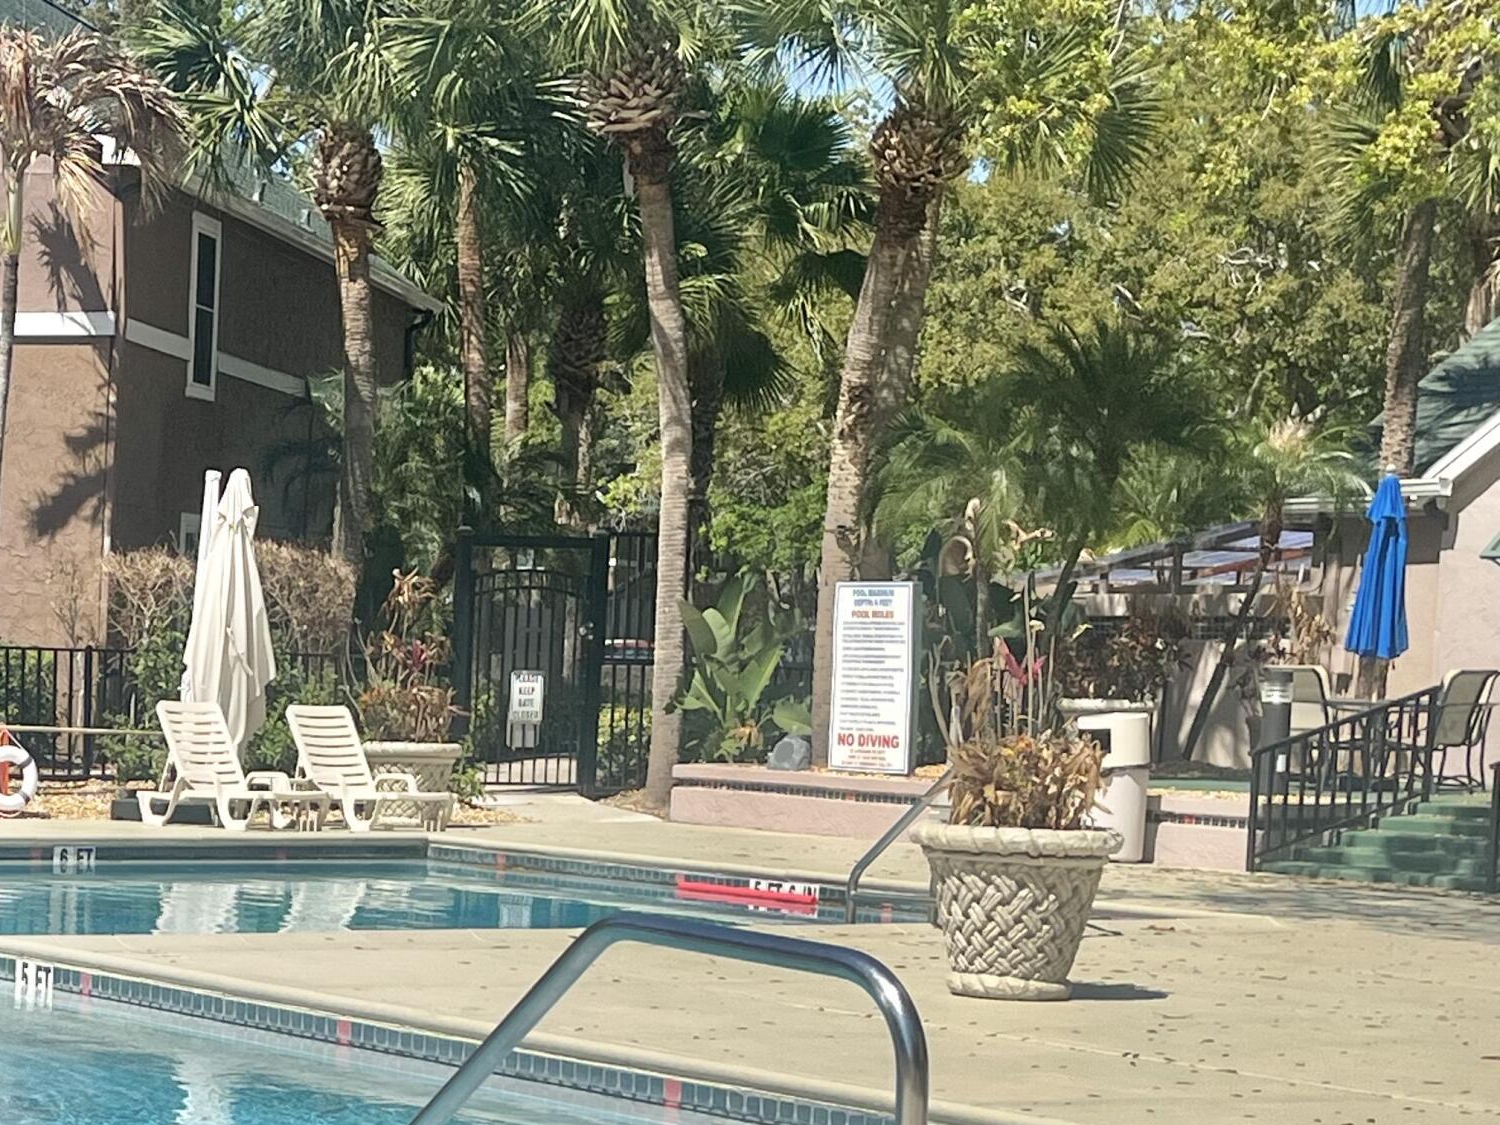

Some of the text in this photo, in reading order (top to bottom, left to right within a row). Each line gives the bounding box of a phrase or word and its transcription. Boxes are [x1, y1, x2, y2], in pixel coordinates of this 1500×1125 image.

[519, 687, 535, 695] KEEP
[837, 732, 900, 748] NO DIVING
[60, 848, 94, 862] 6 FT
[21, 961, 51, 989] 5 FT
